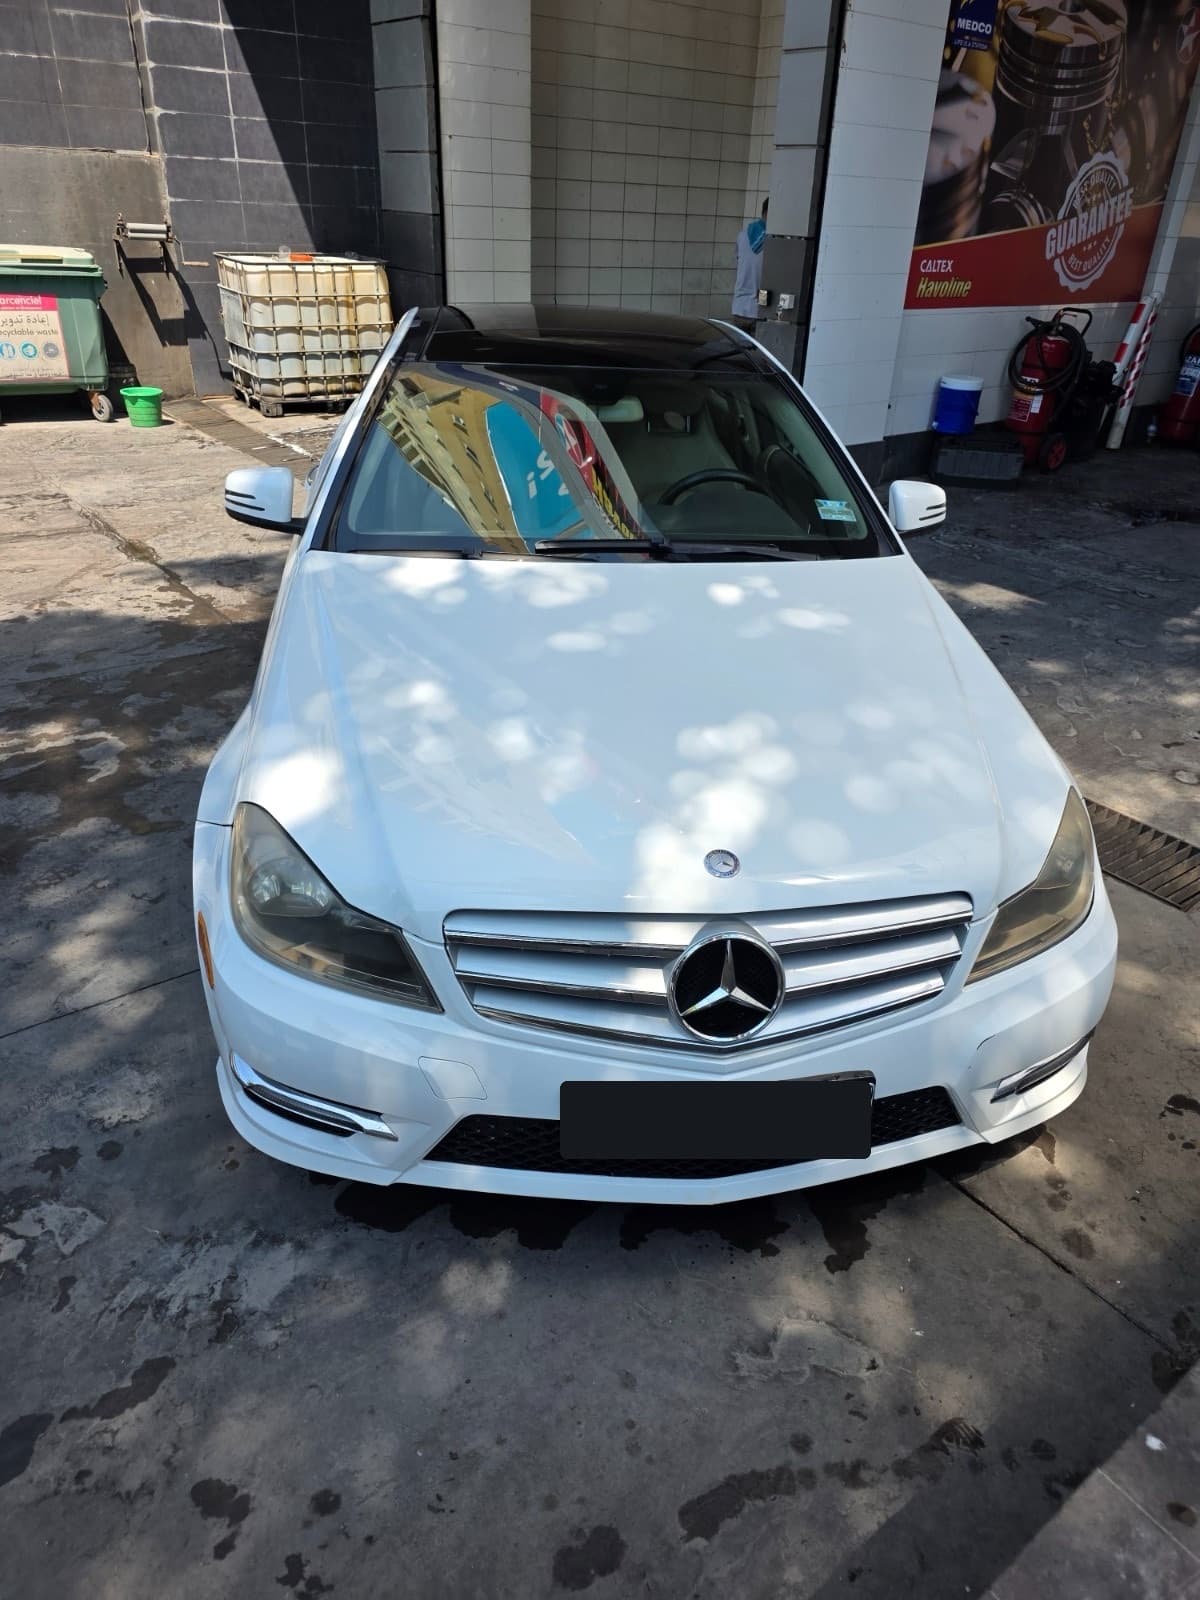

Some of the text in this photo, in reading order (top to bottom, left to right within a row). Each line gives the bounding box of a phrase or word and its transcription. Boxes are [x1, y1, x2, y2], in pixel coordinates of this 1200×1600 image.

[957, 17, 992, 35] MEDCO
[1045, 186, 1135, 261] GUARANTEE
[1067, 236, 1110, 272] BEST QUALITY
[920, 259, 954, 273] CALTEX
[916, 276, 972, 298] Havoline
[0, 328, 35, 338] ecyclable
